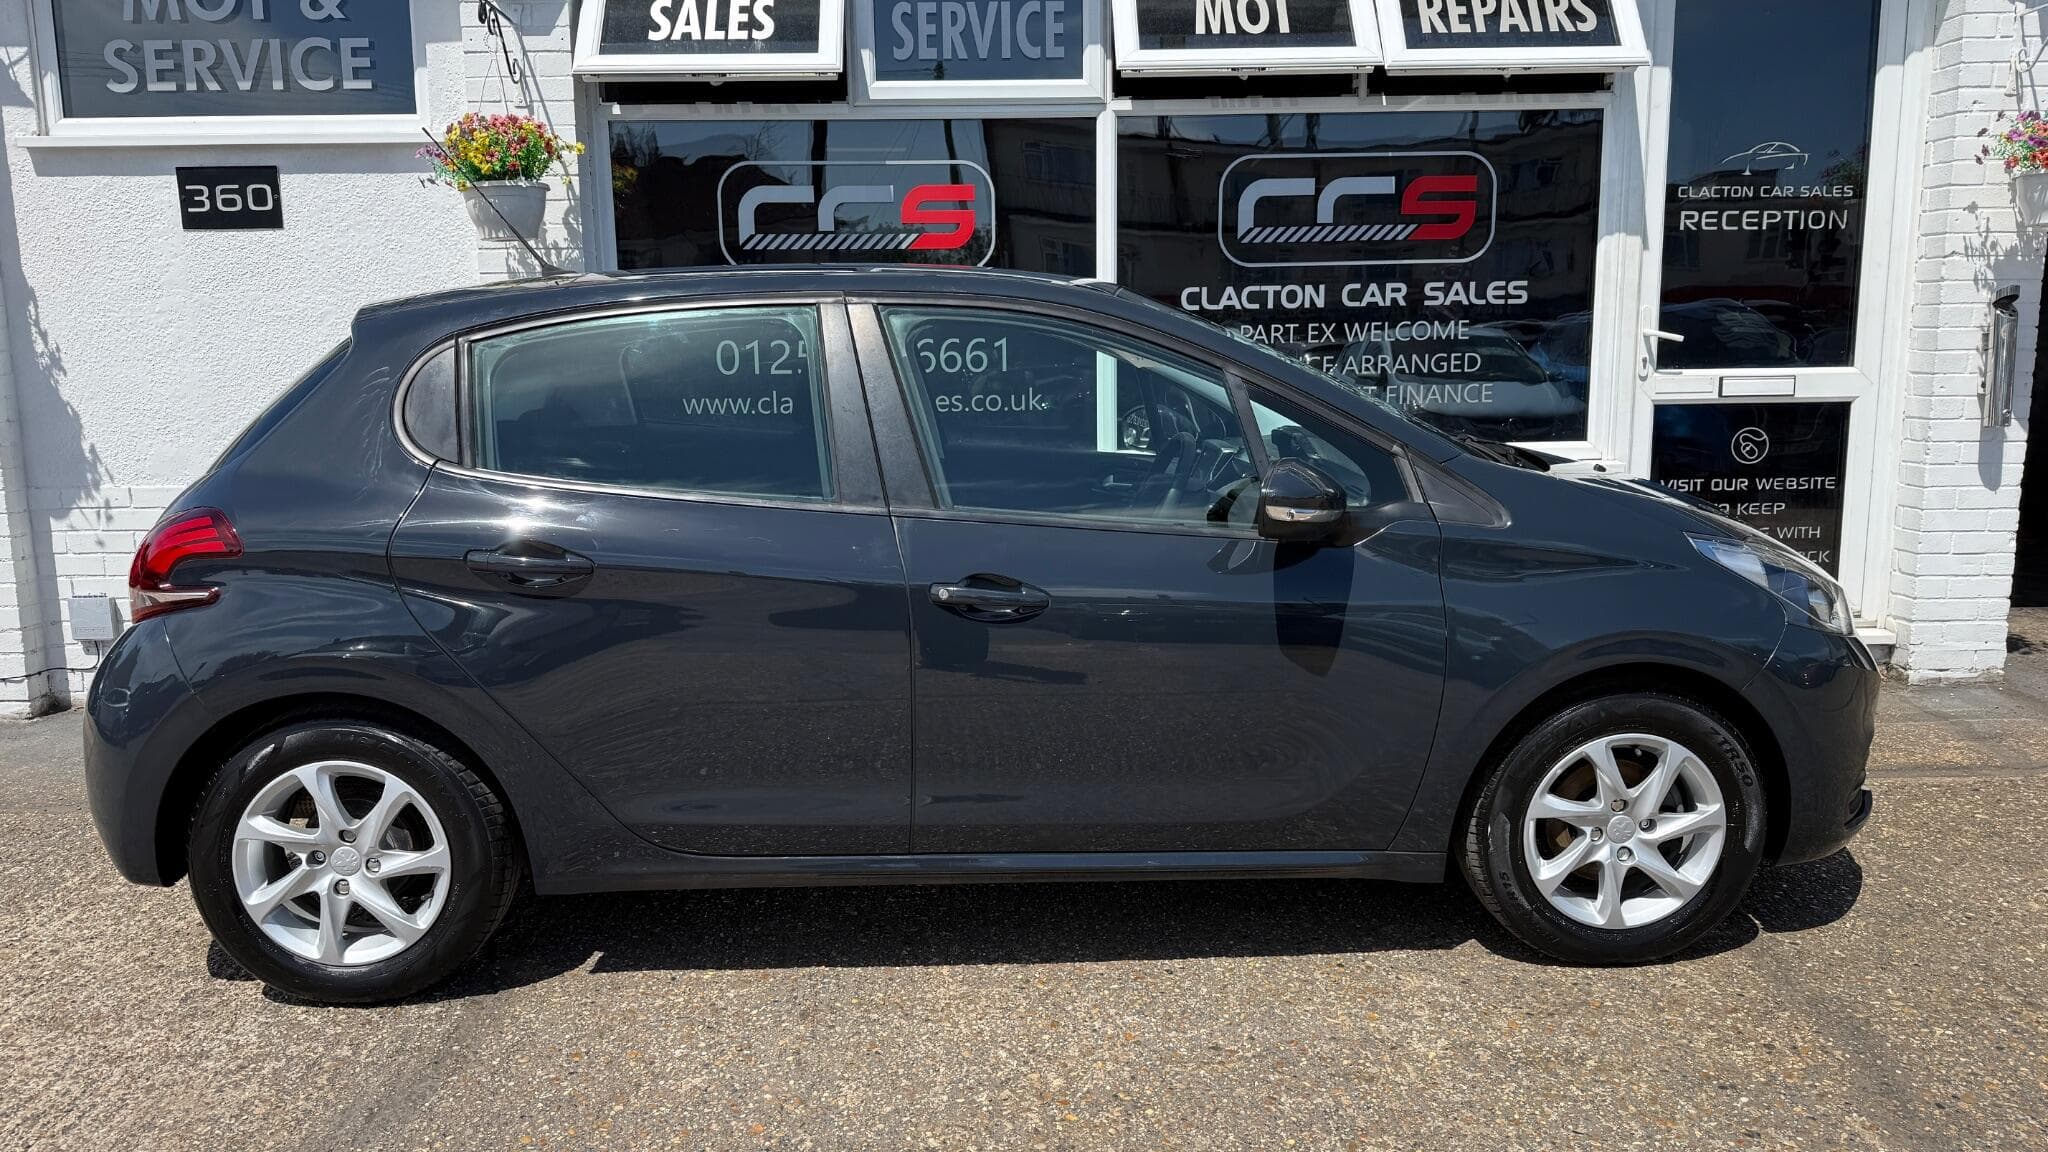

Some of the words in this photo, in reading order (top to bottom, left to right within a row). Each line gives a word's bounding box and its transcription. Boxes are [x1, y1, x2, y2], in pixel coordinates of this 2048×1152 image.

[647, 0, 775, 41] SALES
[1417, 0, 1598, 34] REPAIRS
[891, 0, 1065, 60] SERVICE
[103, 37, 373, 93] SERVICE
[185, 183, 274, 214] 360
[1678, 185, 1754, 199] CLACTON
[1760, 185, 1794, 198] CAR
[1800, 184, 1854, 198] SALES
[1679, 209, 1848, 231] RECEPTION
[1180, 283, 1326, 311] CLACTON
[1341, 282, 1408, 308] CAR
[1423, 280, 1529, 307] SALES
[1240, 323, 1299, 345] PART
[1308, 322, 1337, 344] EX
[1344, 319, 1470, 343] WELCOME
[1342, 352, 1482, 376] ARRANGED
[1386, 383, 1494, 405] FINANCE
[1711, 478, 1749, 491] OUR
[1755, 476, 1837, 490] WEBSITE
[1737, 502, 1786, 515] KEEP
[1776, 525, 1821, 539] WITH
